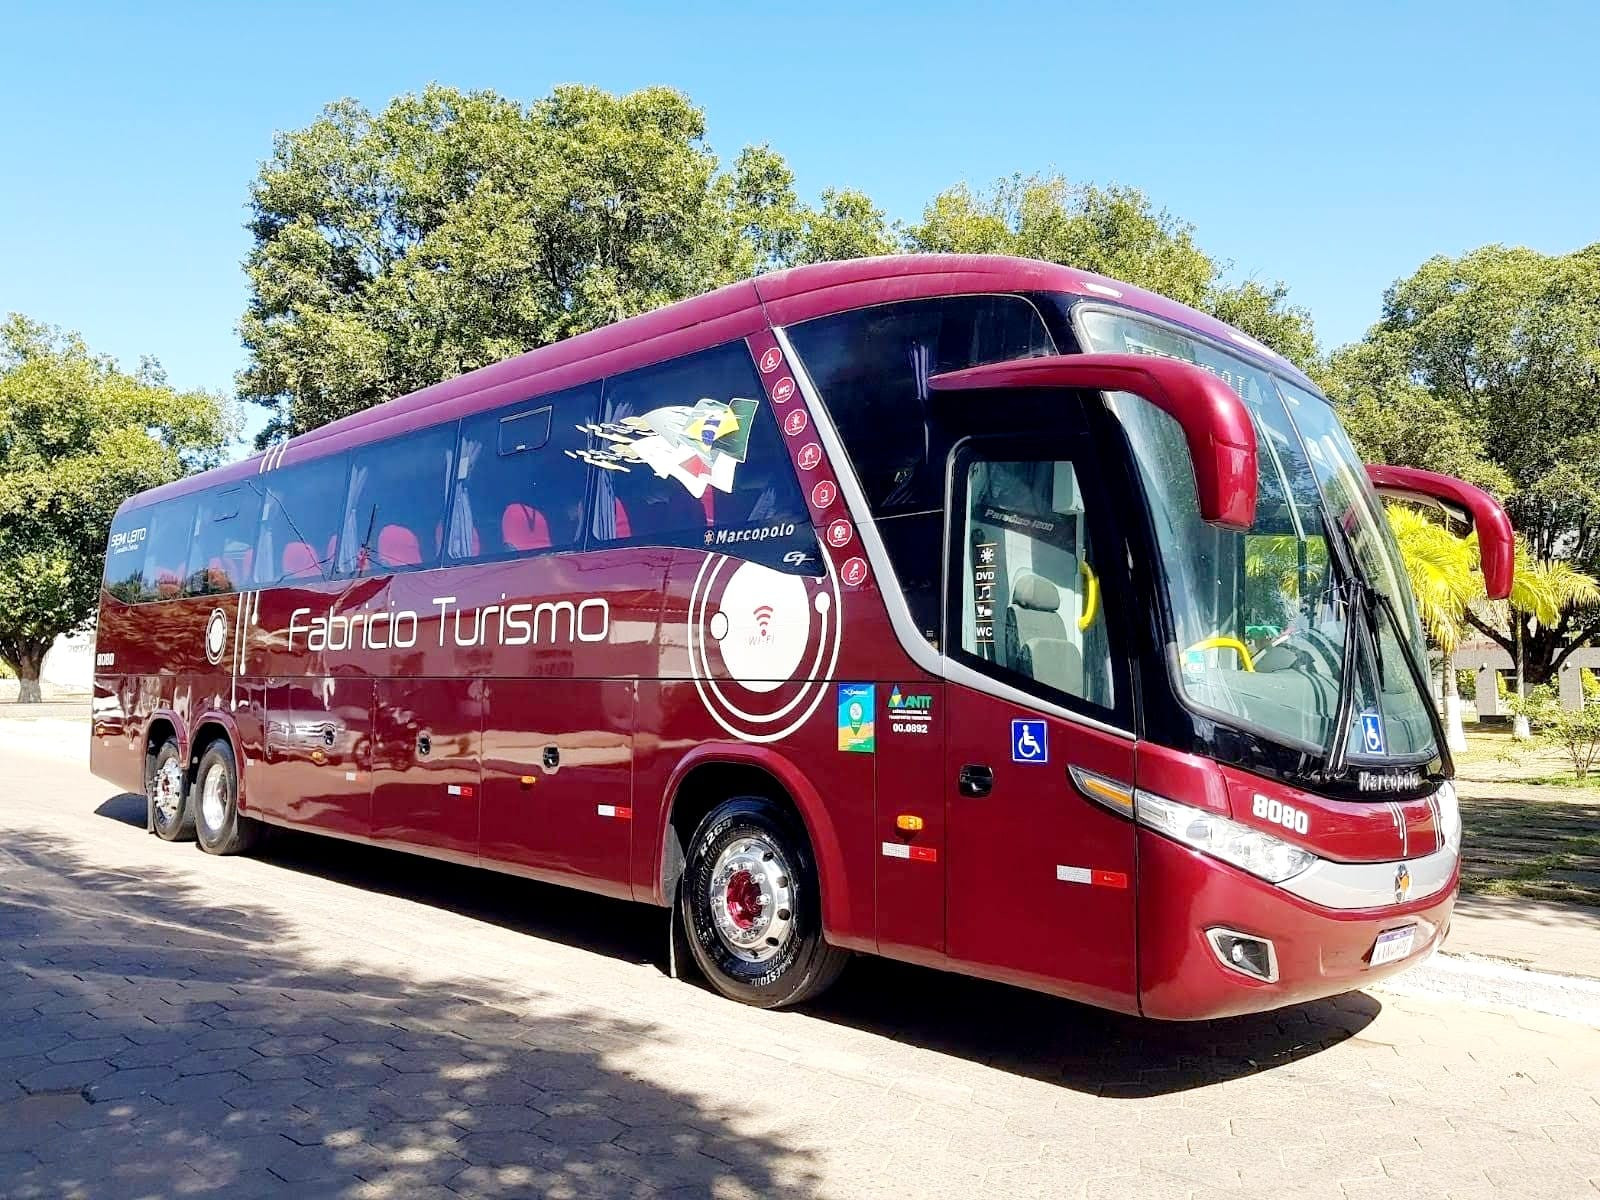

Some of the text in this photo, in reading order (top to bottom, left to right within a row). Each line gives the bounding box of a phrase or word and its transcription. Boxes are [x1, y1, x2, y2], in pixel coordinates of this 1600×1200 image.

[715, 522, 795, 545] Marcopolo
[976, 571, 995, 581] DVD
[288, 593, 609, 652] Fabricio Turismo
[976, 626, 993, 637] WC
[96, 652, 115, 666] 8080
[904, 695, 932, 709] ANTT
[1358, 771, 1420, 792] Marcopolo
[1252, 793, 1309, 835] 8080
